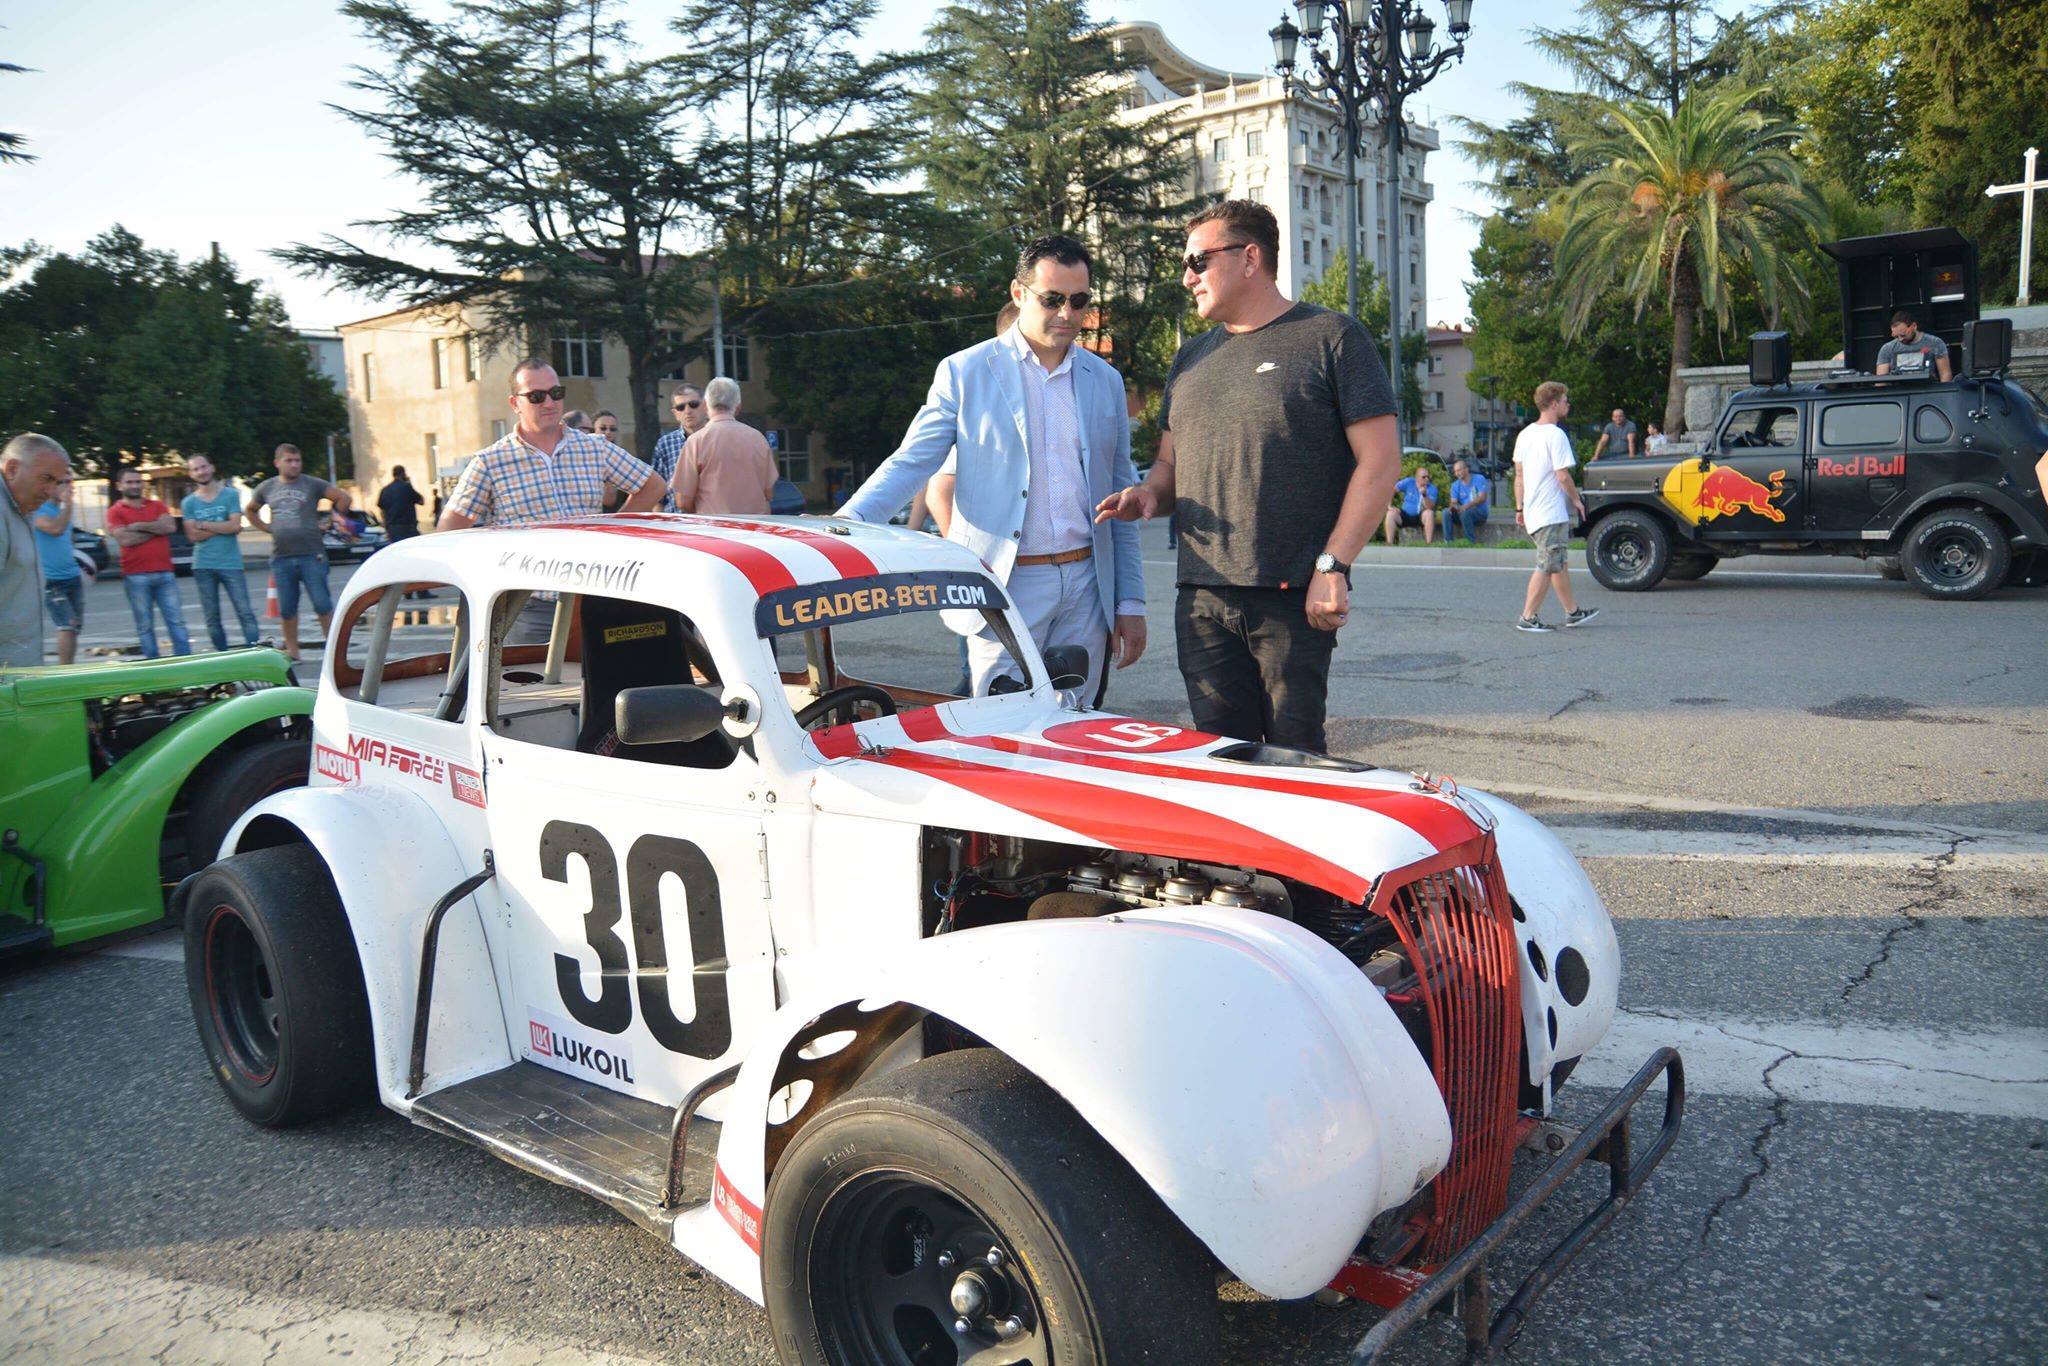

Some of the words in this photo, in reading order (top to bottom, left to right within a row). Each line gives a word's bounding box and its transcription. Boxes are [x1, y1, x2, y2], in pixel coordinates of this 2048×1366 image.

[1817, 456, 1859, 476] Red
[1863, 455, 1905, 476] Bull
[775, 584, 987, 627] LEADER-BET.COM
[607, 622, 664, 638] RICHARDSON
[318, 749, 360, 783] MOTUL
[348, 733, 387, 766] MIA
[388, 748, 445, 784] FORCE
[540, 819, 732, 1060] 30
[552, 1032, 634, 1084] LUKOIL
